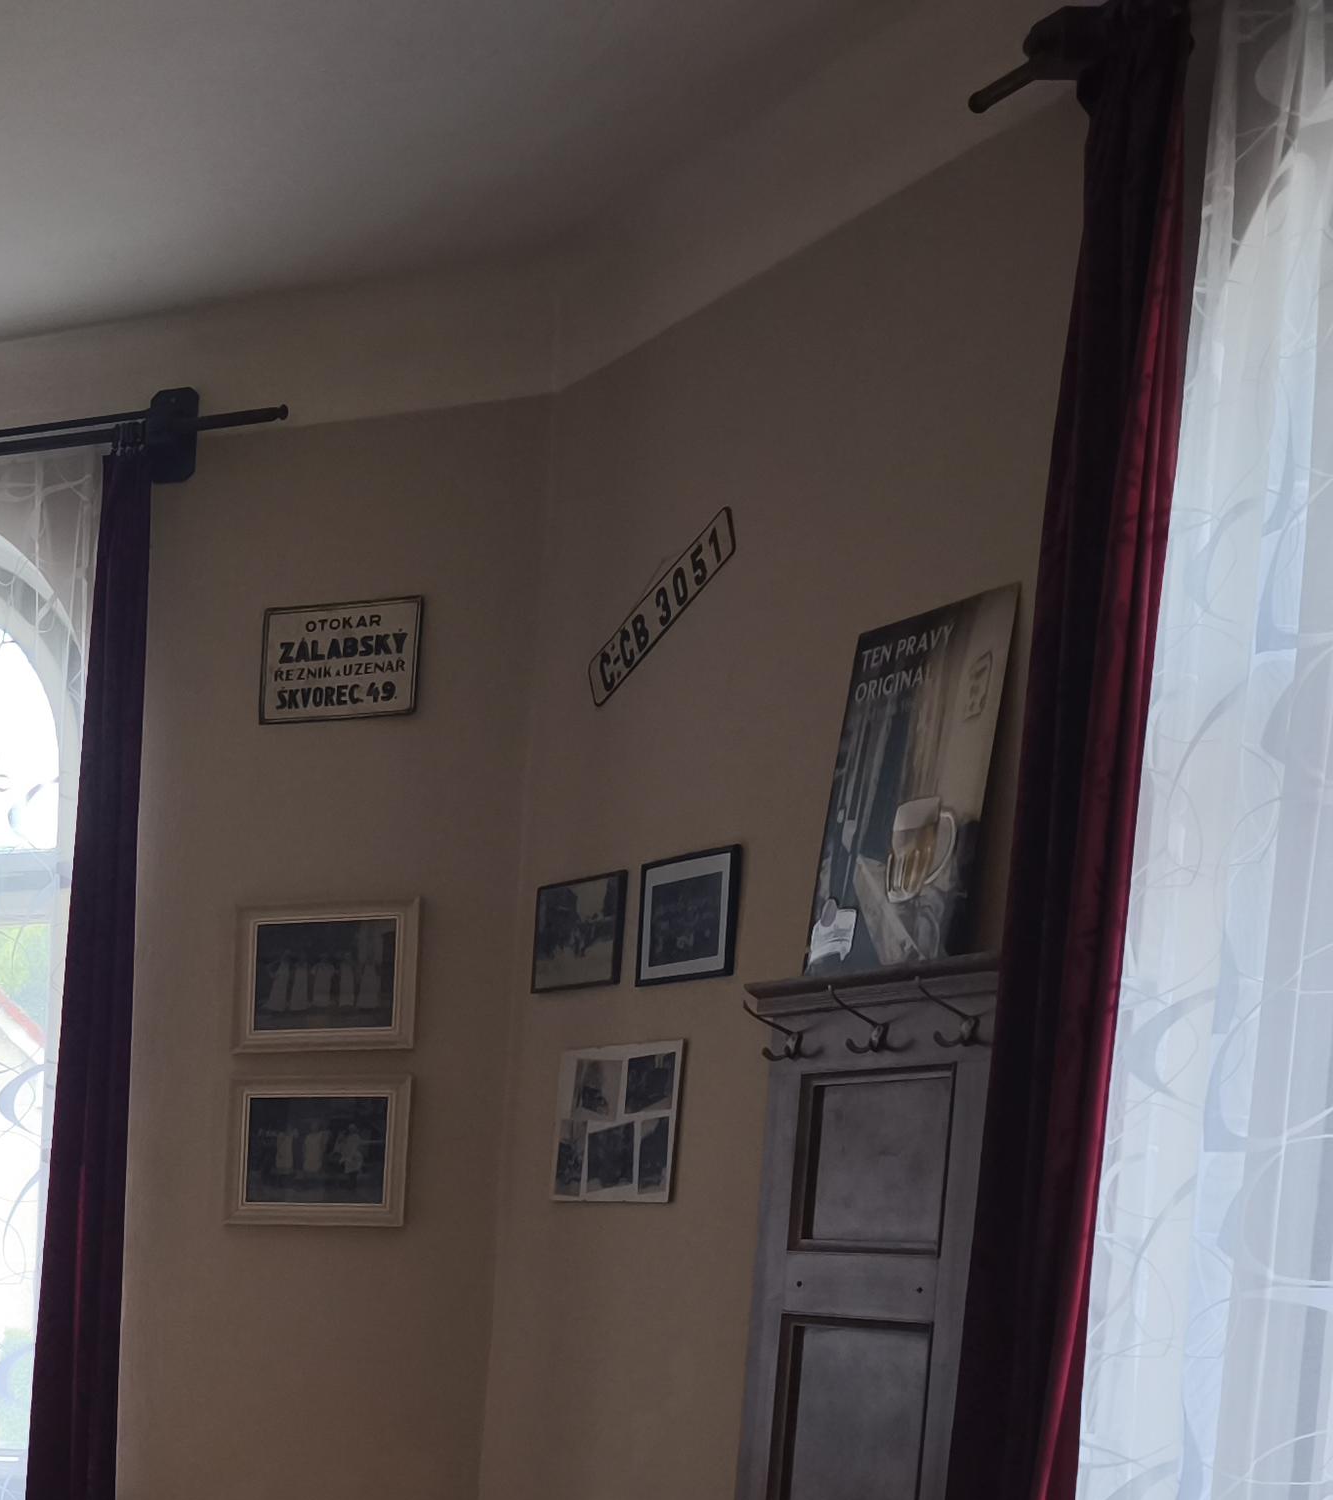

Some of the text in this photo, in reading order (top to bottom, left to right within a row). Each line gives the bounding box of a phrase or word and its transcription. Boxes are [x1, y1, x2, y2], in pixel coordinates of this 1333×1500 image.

[655, 526, 721, 627] 3051
[305, 614, 382, 633] OTOKAR
[278, 628, 408, 665] ZÁLABSKÝ
[861, 642, 893, 673] TEN
